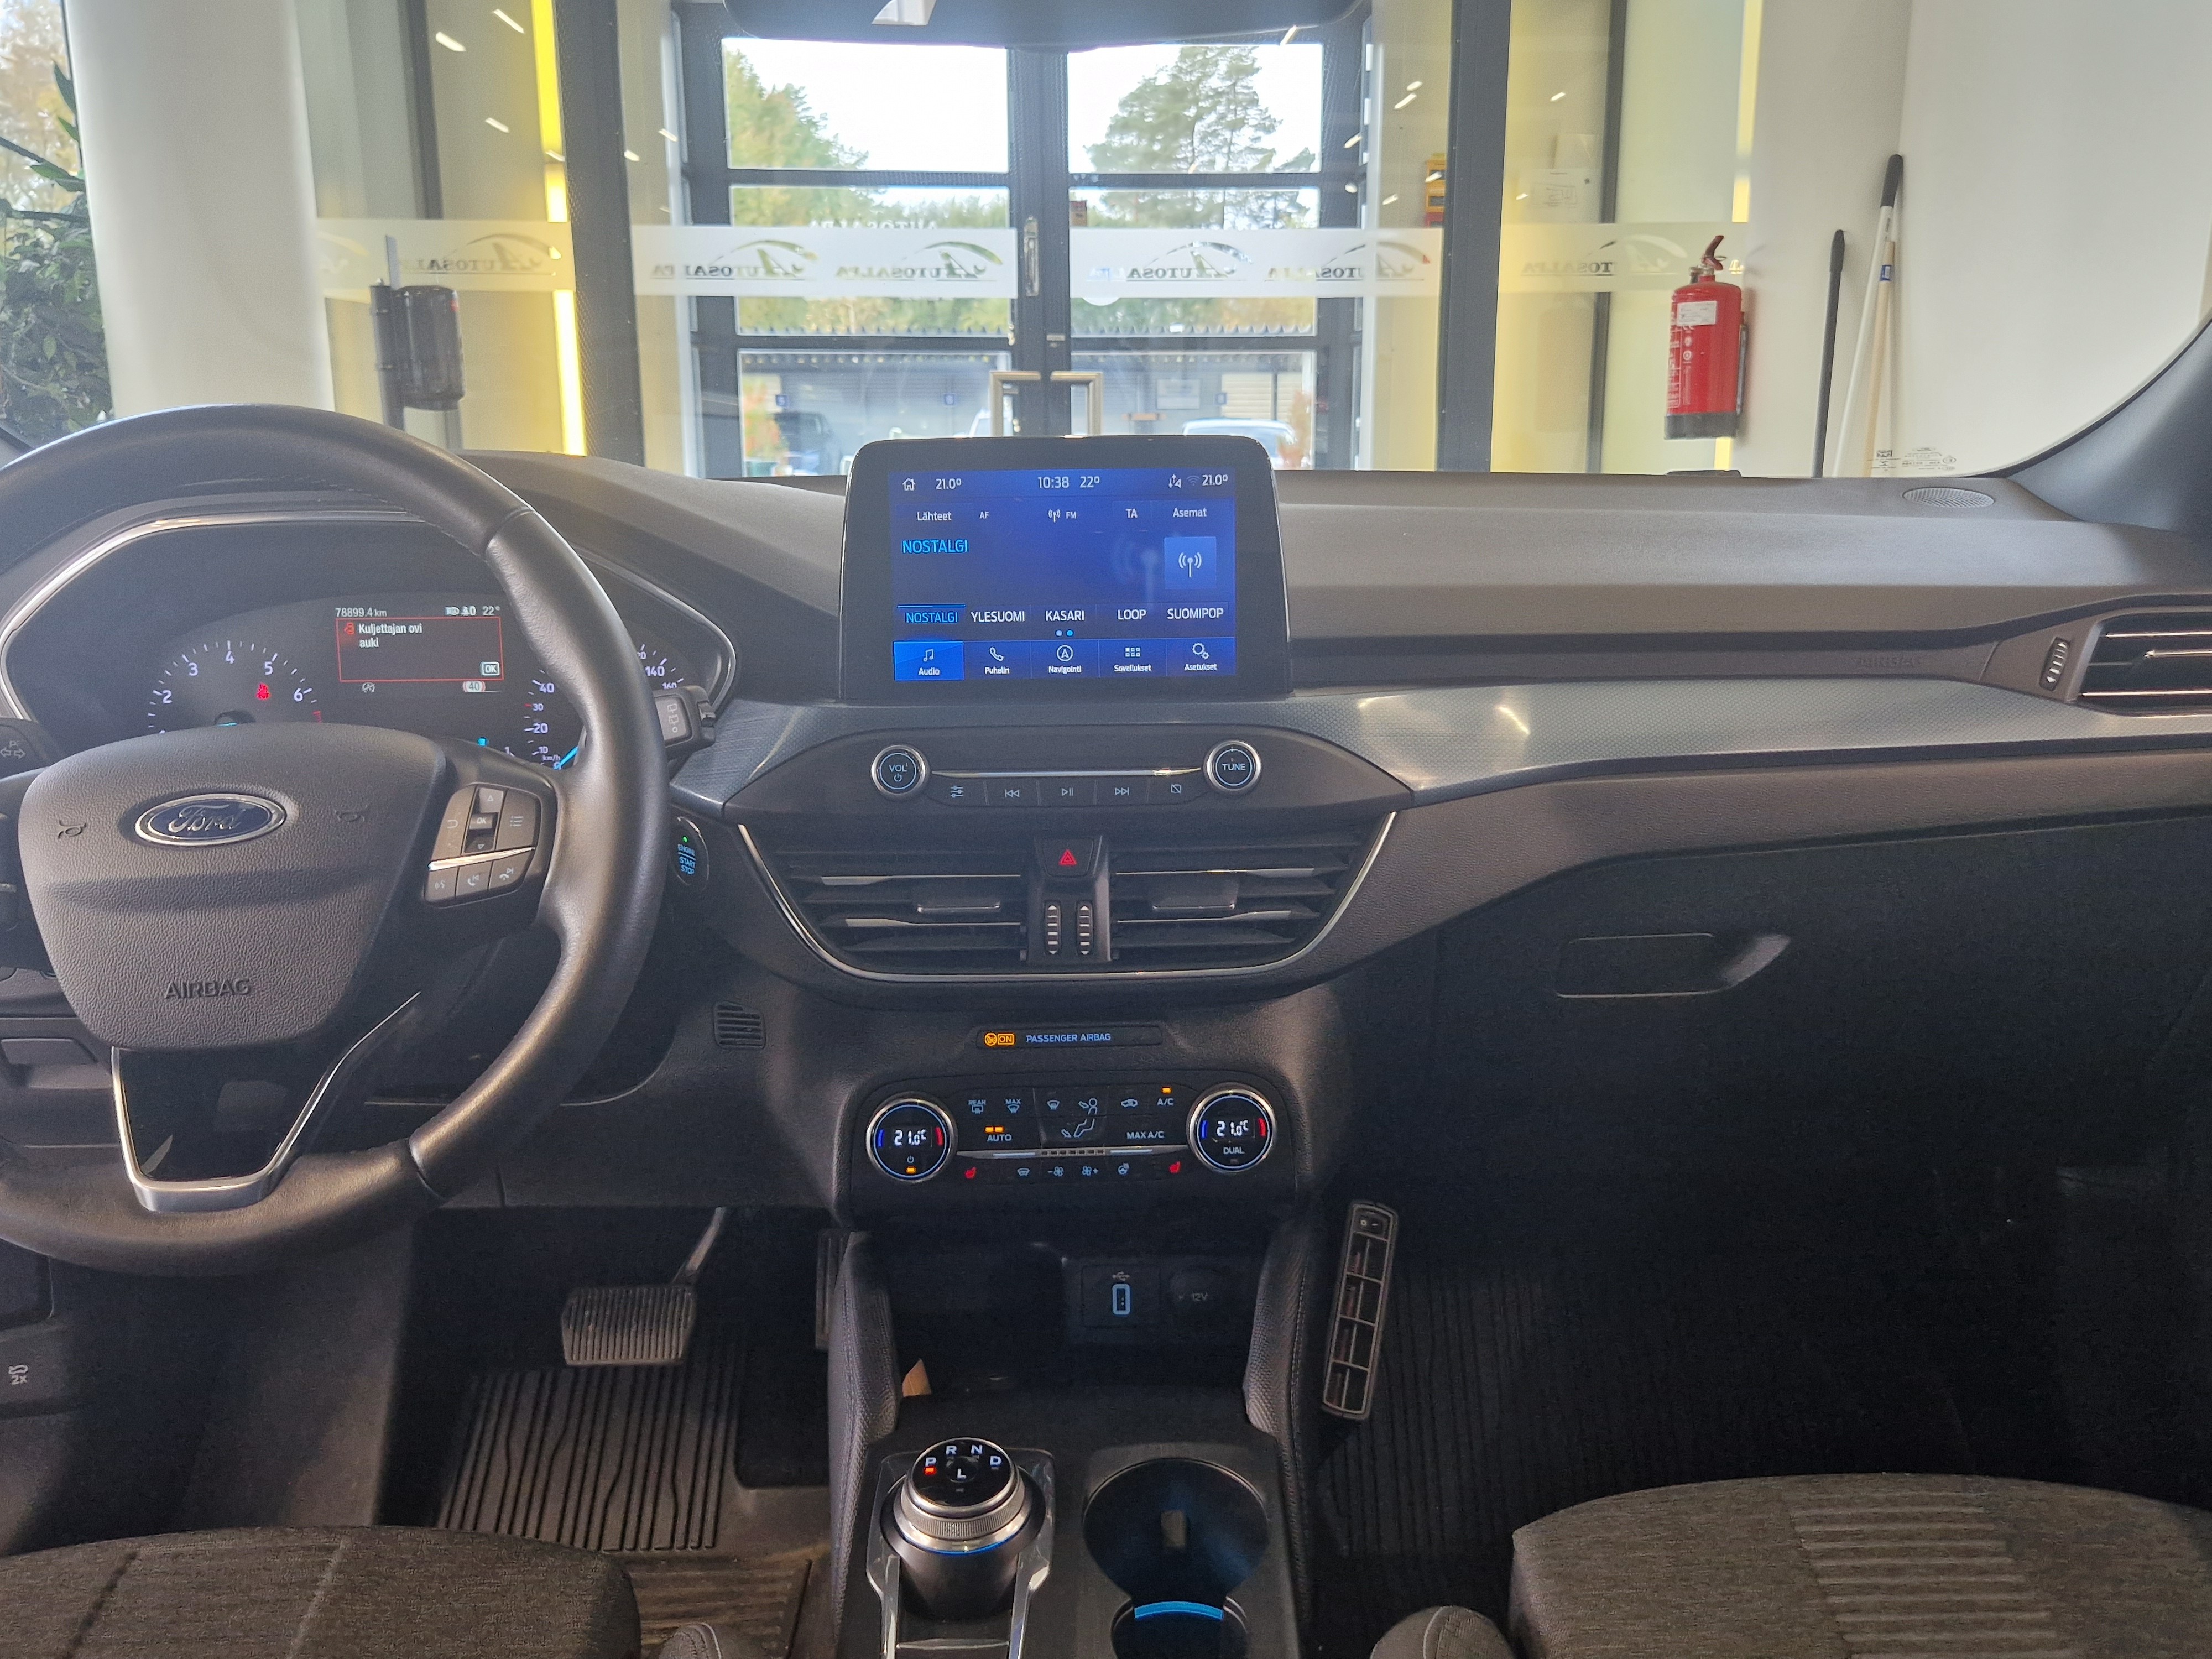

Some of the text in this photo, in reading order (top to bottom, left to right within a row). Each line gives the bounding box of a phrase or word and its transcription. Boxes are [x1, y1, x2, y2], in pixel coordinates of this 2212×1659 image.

[1037, 476, 1070, 488] 10:38
[917, 511, 952, 521] Lähteet
[1066, 511, 1077, 519] FM
[1125, 508, 1138, 518] TA
[1172, 508, 1207, 518] Asemat
[902, 539, 968, 553] NOSTALGI
[335, 608, 373, 617] 78899.4
[906, 612, 958, 623] NOSTALGI
[971, 611, 1025, 622] YLESUOMI
[1046, 610, 1084, 621] KASARI
[1118, 609, 1146, 620] LOOP
[1167, 608, 1224, 619] SUOMIPOP
[358, 623, 422, 635] Kuljettajan ovi
[359, 638, 379, 648] auki
[225, 650, 234, 664] 4
[189, 663, 198, 676] 3
[264, 661, 273, 675] 5
[485, 664, 497, 674] OK
[645, 666, 665, 676] 140
[919, 667, 940, 675] Audio
[1048, 666, 1082, 674] Navigointi
[1114, 664, 1152, 672] Sovellukset
[468, 682, 480, 691] 40
[540, 682, 554, 693] 40
[162, 690, 172, 703] 2
[294, 688, 304, 701] 6
[533, 703, 544, 711] 30
[533, 723, 548, 734] 20
[504, 747, 509, 755] 1
[889, 764, 907, 773] VOL
[1222, 763, 1245, 771] TUNE
[168, 804, 247, 833] Ford
[679, 857, 696, 868] START
[681, 864, 695, 875] STOP
[165, 978, 251, 999] AIRBAG
[1026, 1033, 1111, 1042] PASSENGER AIRBAG
[1157, 1098, 1174, 1106] A/C
[987, 1134, 1012, 1142] AUTO
[1127, 1130, 1165, 1139] MAX A/C
[1223, 1146, 1245, 1155] DUAL
[1192, 1292, 1208, 1301] 12V
[946, 1445, 957, 1455] R
[971, 1444, 983, 1454] N
[925, 1457, 937, 1467] P
[989, 1455, 1002, 1466] D
[957, 1468, 967, 1479] L
